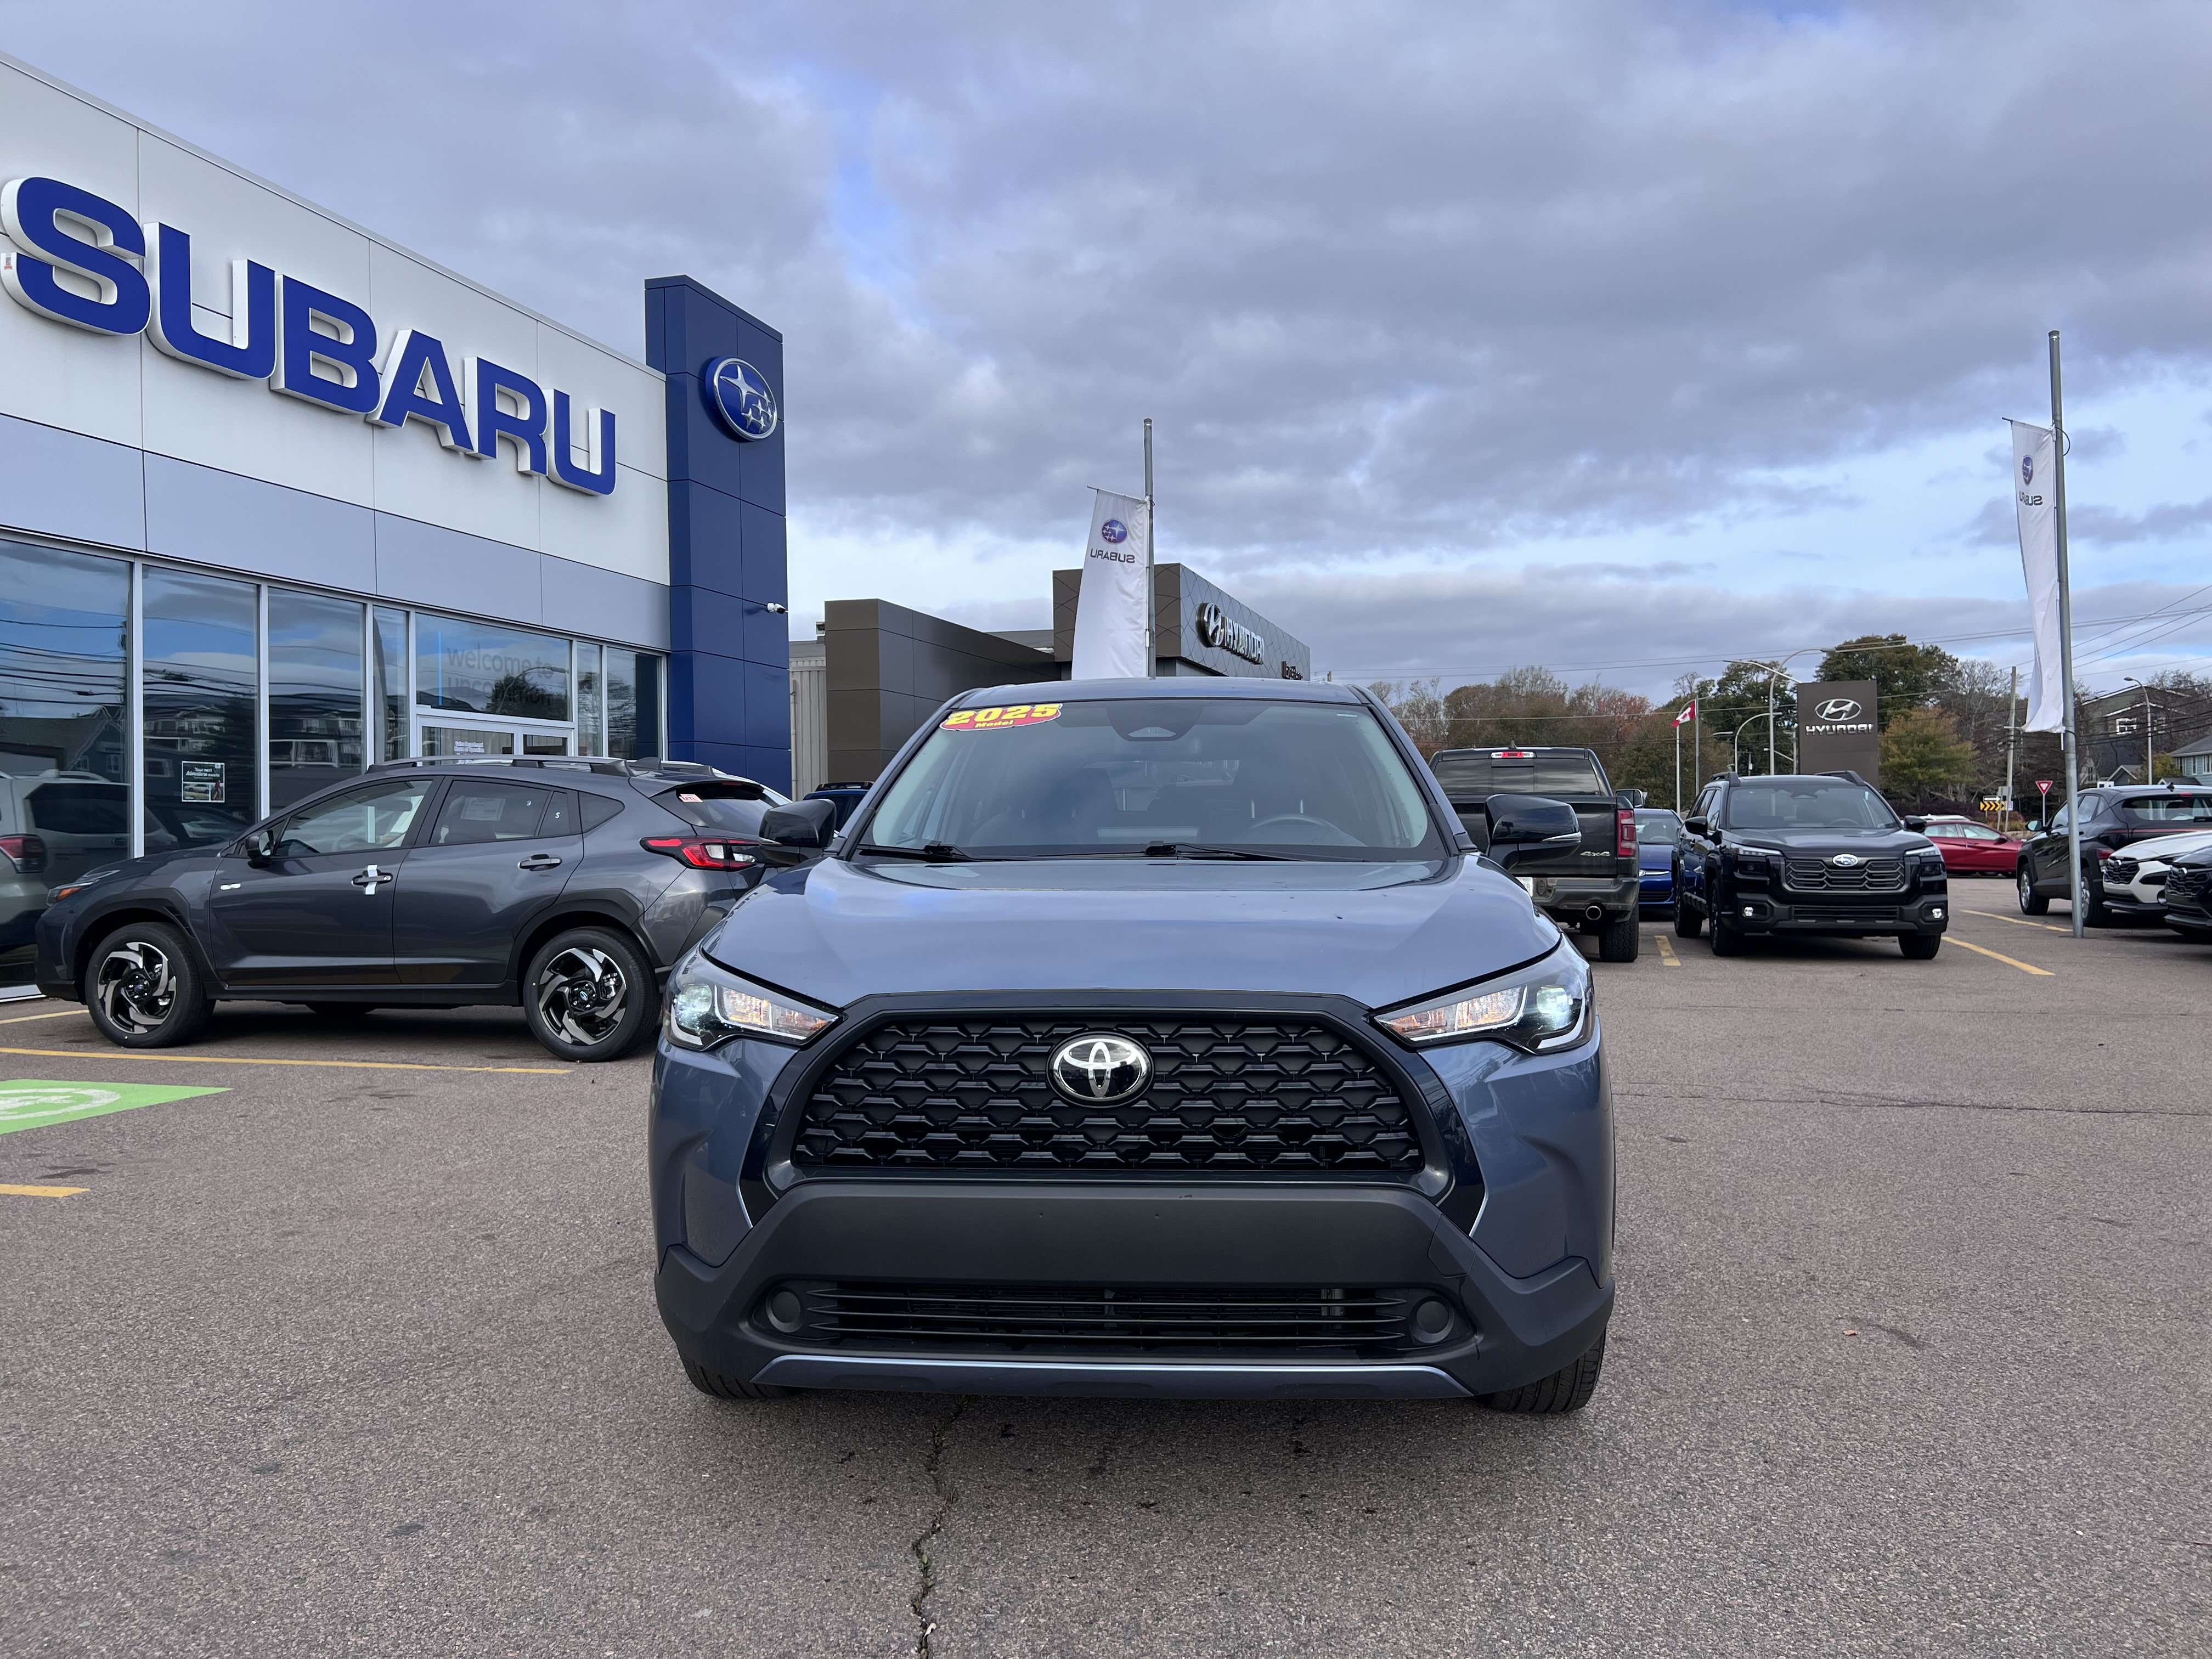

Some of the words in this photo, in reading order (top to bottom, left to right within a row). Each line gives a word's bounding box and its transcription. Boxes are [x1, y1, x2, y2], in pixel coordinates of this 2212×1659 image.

[16, 176, 616, 495] SUBARU
[1225, 616, 1265, 665] HYUNDAI
[447, 642, 531, 678] welcome
[535, 657, 554, 680] to
[945, 703, 1062, 726] 2025
[974, 720, 1014, 728] Model
[1805, 724, 1873, 735] HYUNDAI
